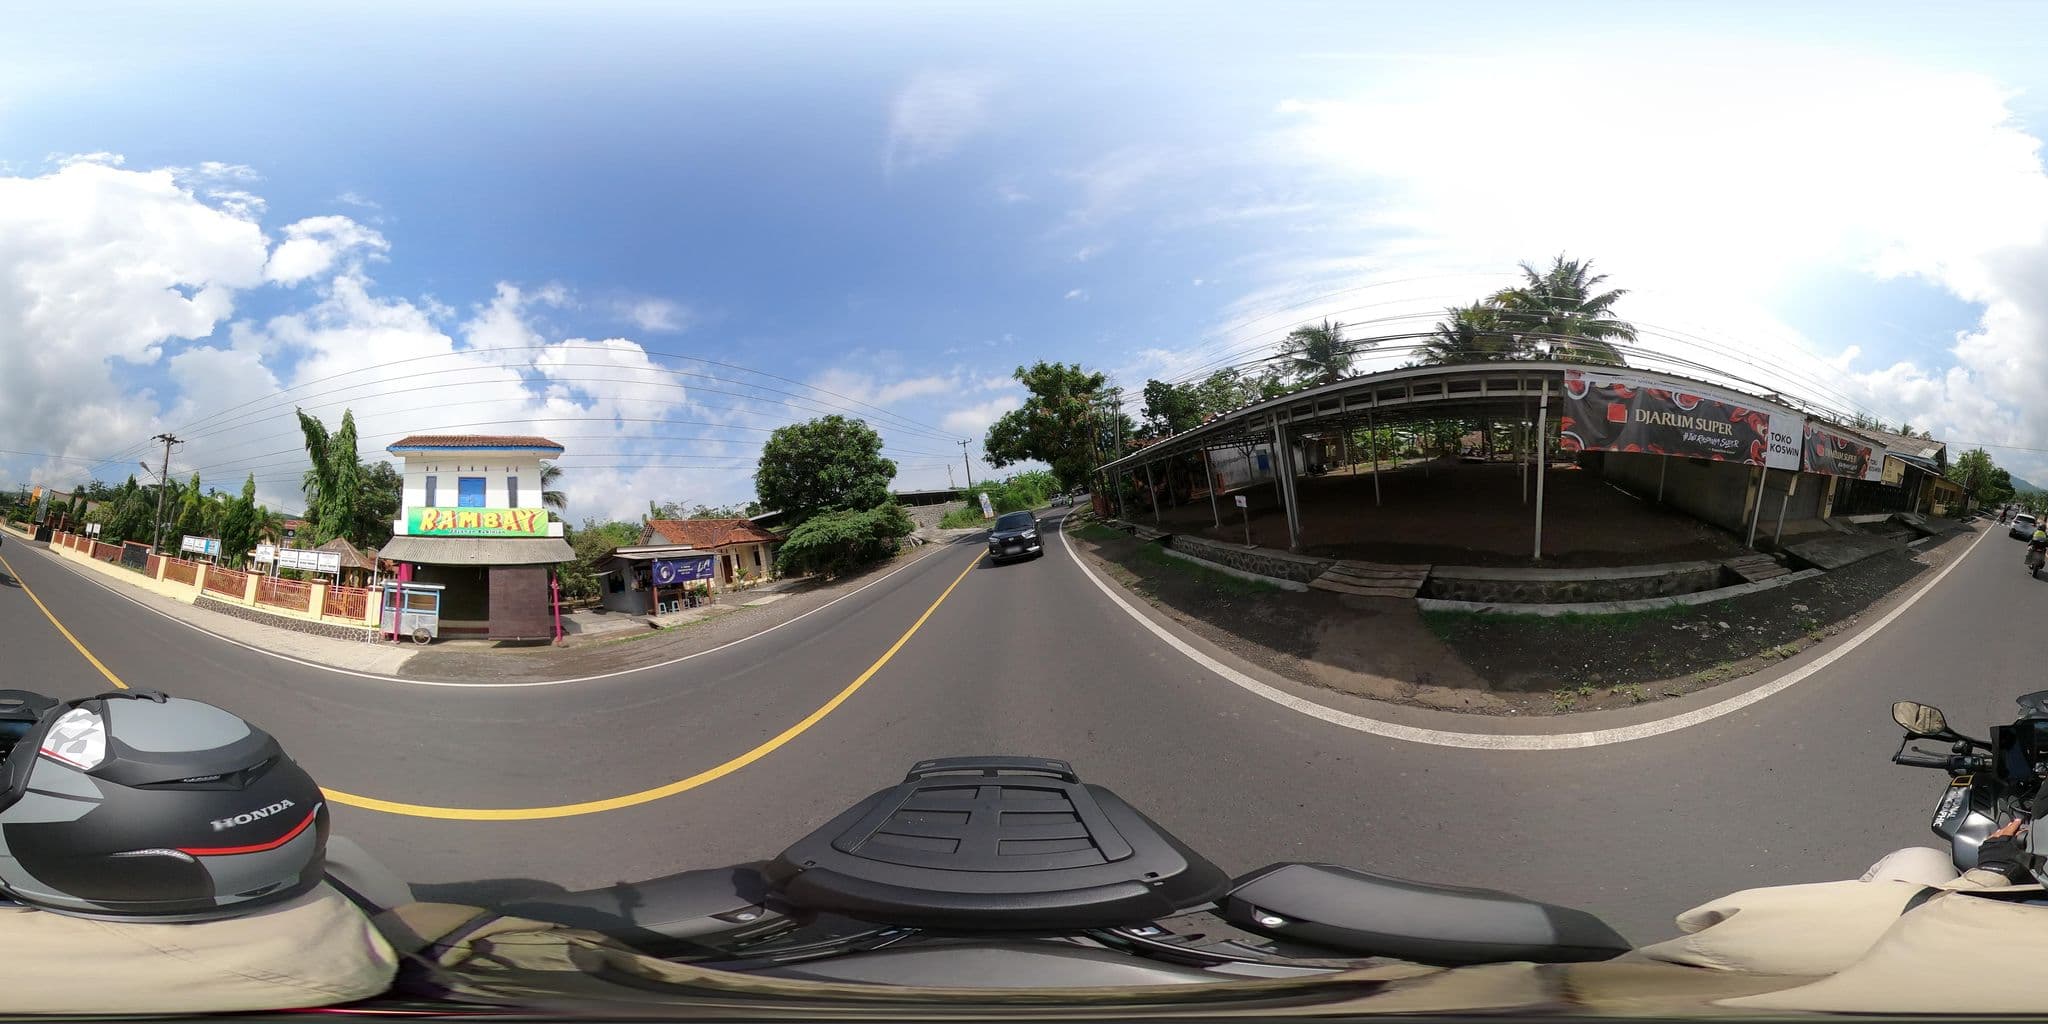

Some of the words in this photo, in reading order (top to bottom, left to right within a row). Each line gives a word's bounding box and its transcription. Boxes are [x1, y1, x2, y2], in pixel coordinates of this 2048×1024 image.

[1635, 409, 1694, 428] DJARUM
[1695, 419, 1733, 436] SUPER
[1769, 433, 1792, 445] TOKO
[1769, 443, 1800, 457] KOSWIN
[420, 508, 542, 533] RAMBAY
[210, 799, 295, 831] HONDA
